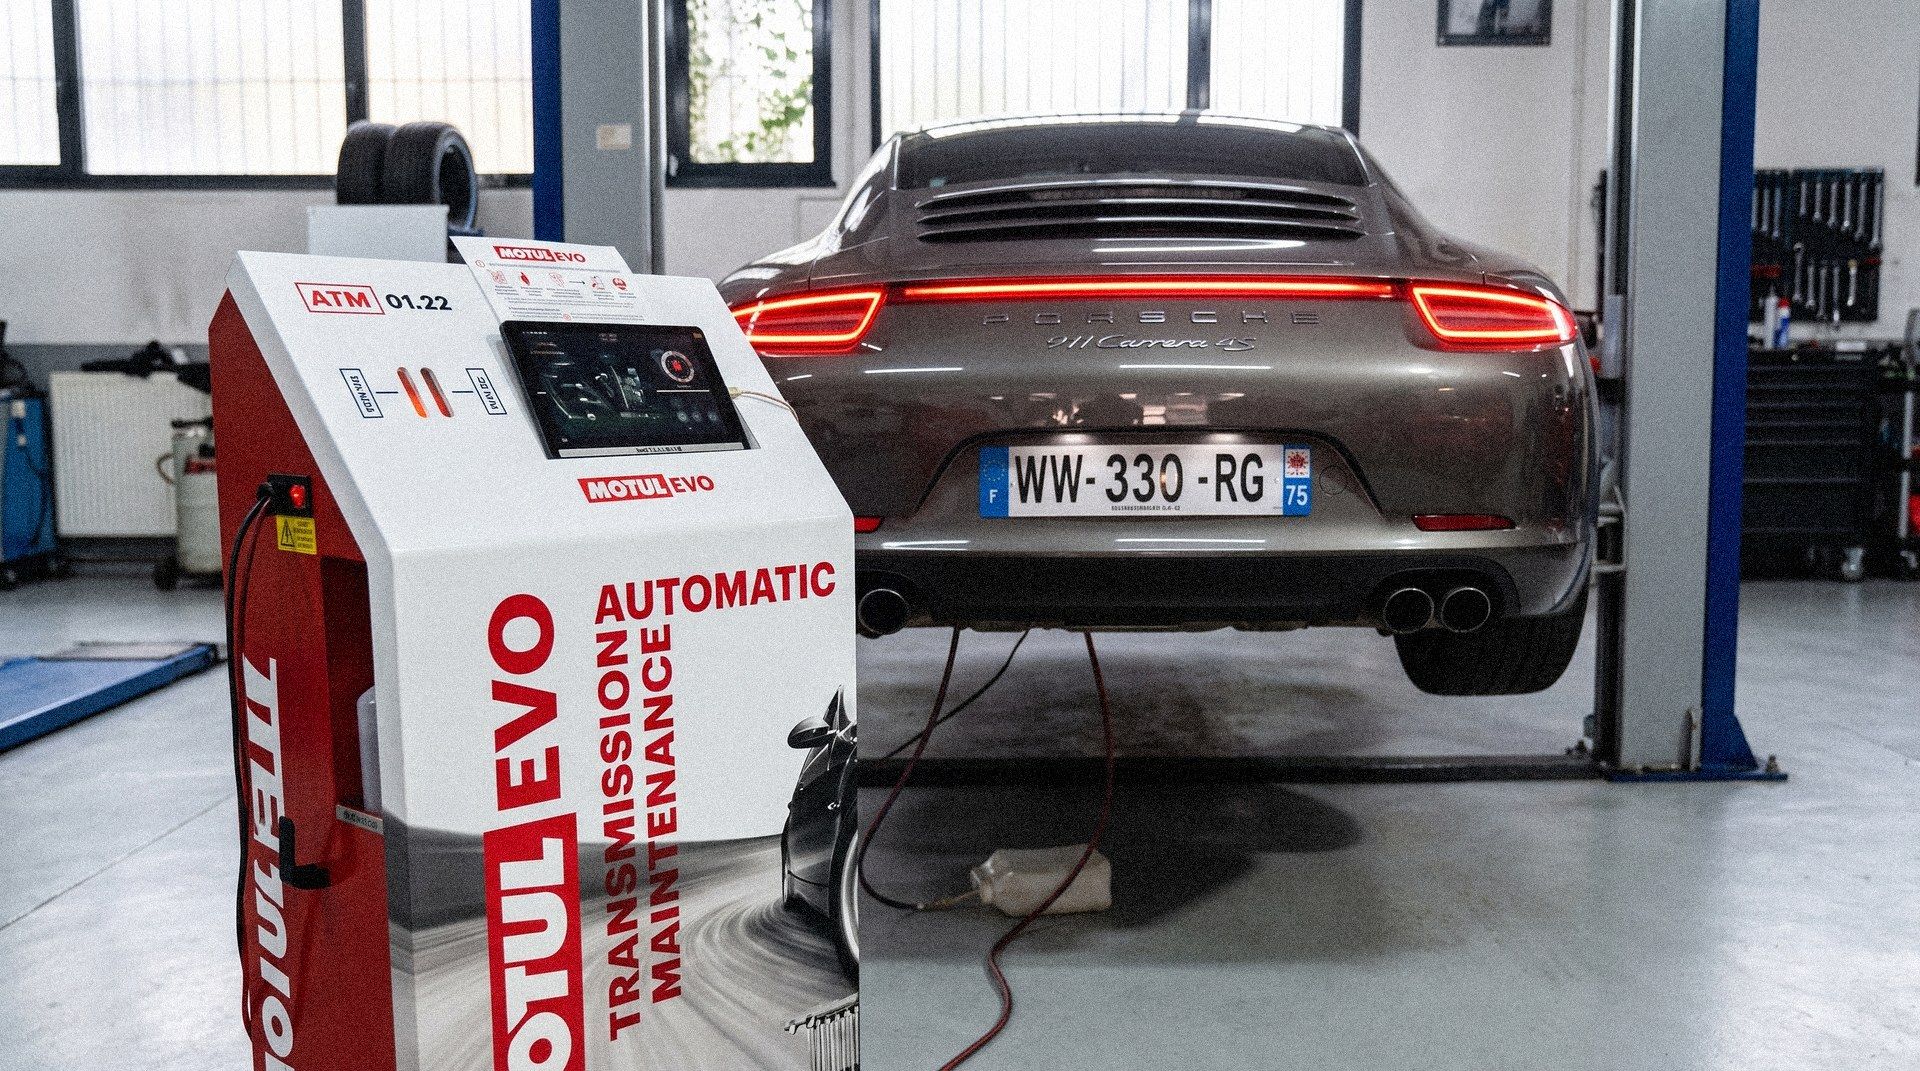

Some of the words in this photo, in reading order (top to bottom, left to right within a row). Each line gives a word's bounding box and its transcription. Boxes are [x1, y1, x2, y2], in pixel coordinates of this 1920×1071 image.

[499, 247, 553, 262] MOTUL
[554, 252, 587, 263] EVO
[312, 290, 372, 308] ATM
[385, 293, 453, 311] 01.22
[983, 310, 1319, 326] PORSCHE
[1047, 335, 1095, 350] 911
[1096, 334, 1209, 350] Carrera
[1213, 336, 1258, 352] 4S
[586, 477, 669, 500] MOTUL
[668, 475, 715, 493] EVO
[989, 489, 999, 504] F
[1285, 484, 1309, 506] 75
[594, 561, 836, 625] AUTOMATIC
[487, 593, 562, 812] EVO
[639, 623, 682, 1004] MAINTENANCE
[594, 629, 642, 1042] TRANSMISSION
[499, 837, 573, 1071] OTUL
